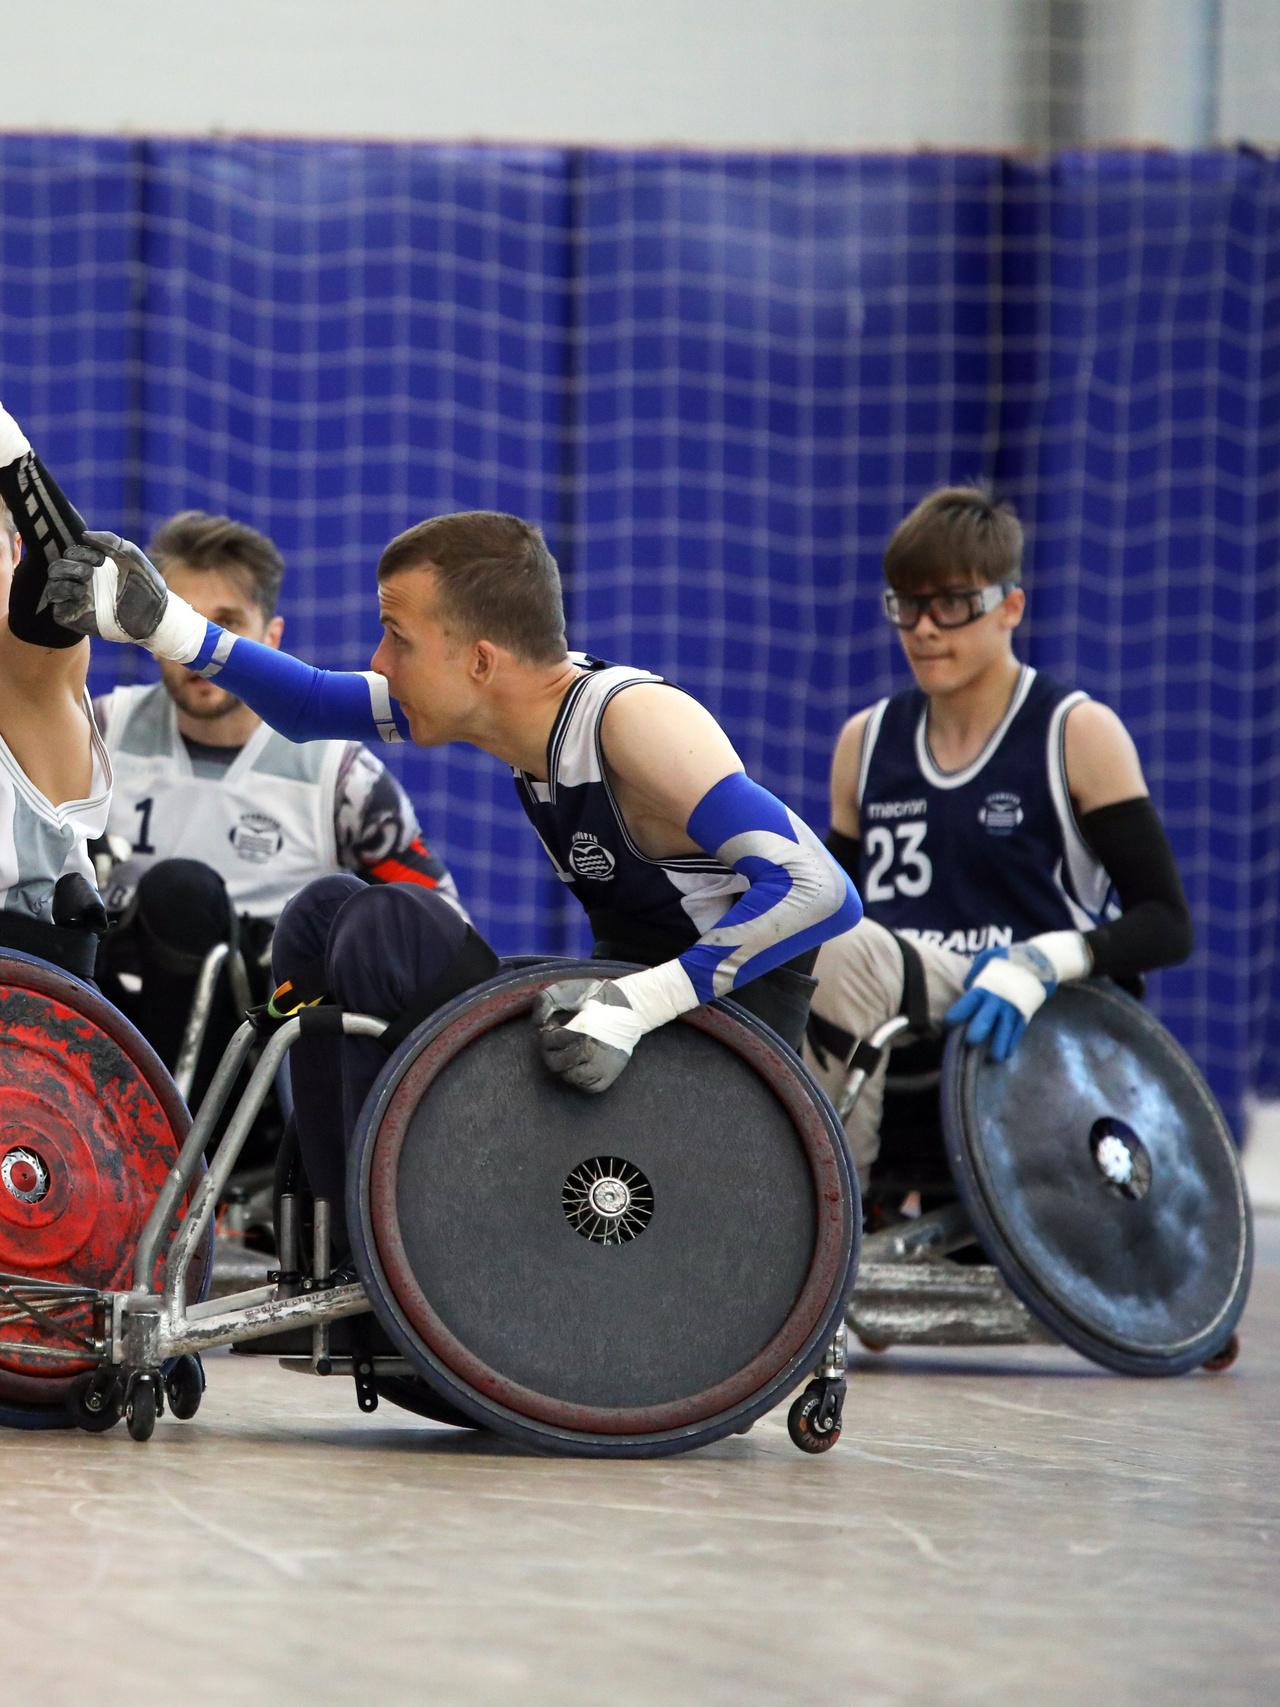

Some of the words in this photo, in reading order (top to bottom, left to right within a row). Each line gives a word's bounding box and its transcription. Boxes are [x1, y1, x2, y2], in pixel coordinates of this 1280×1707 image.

[132, 797, 156, 855] 1
[867, 799, 927, 819] macron
[866, 821, 933, 903] 23
